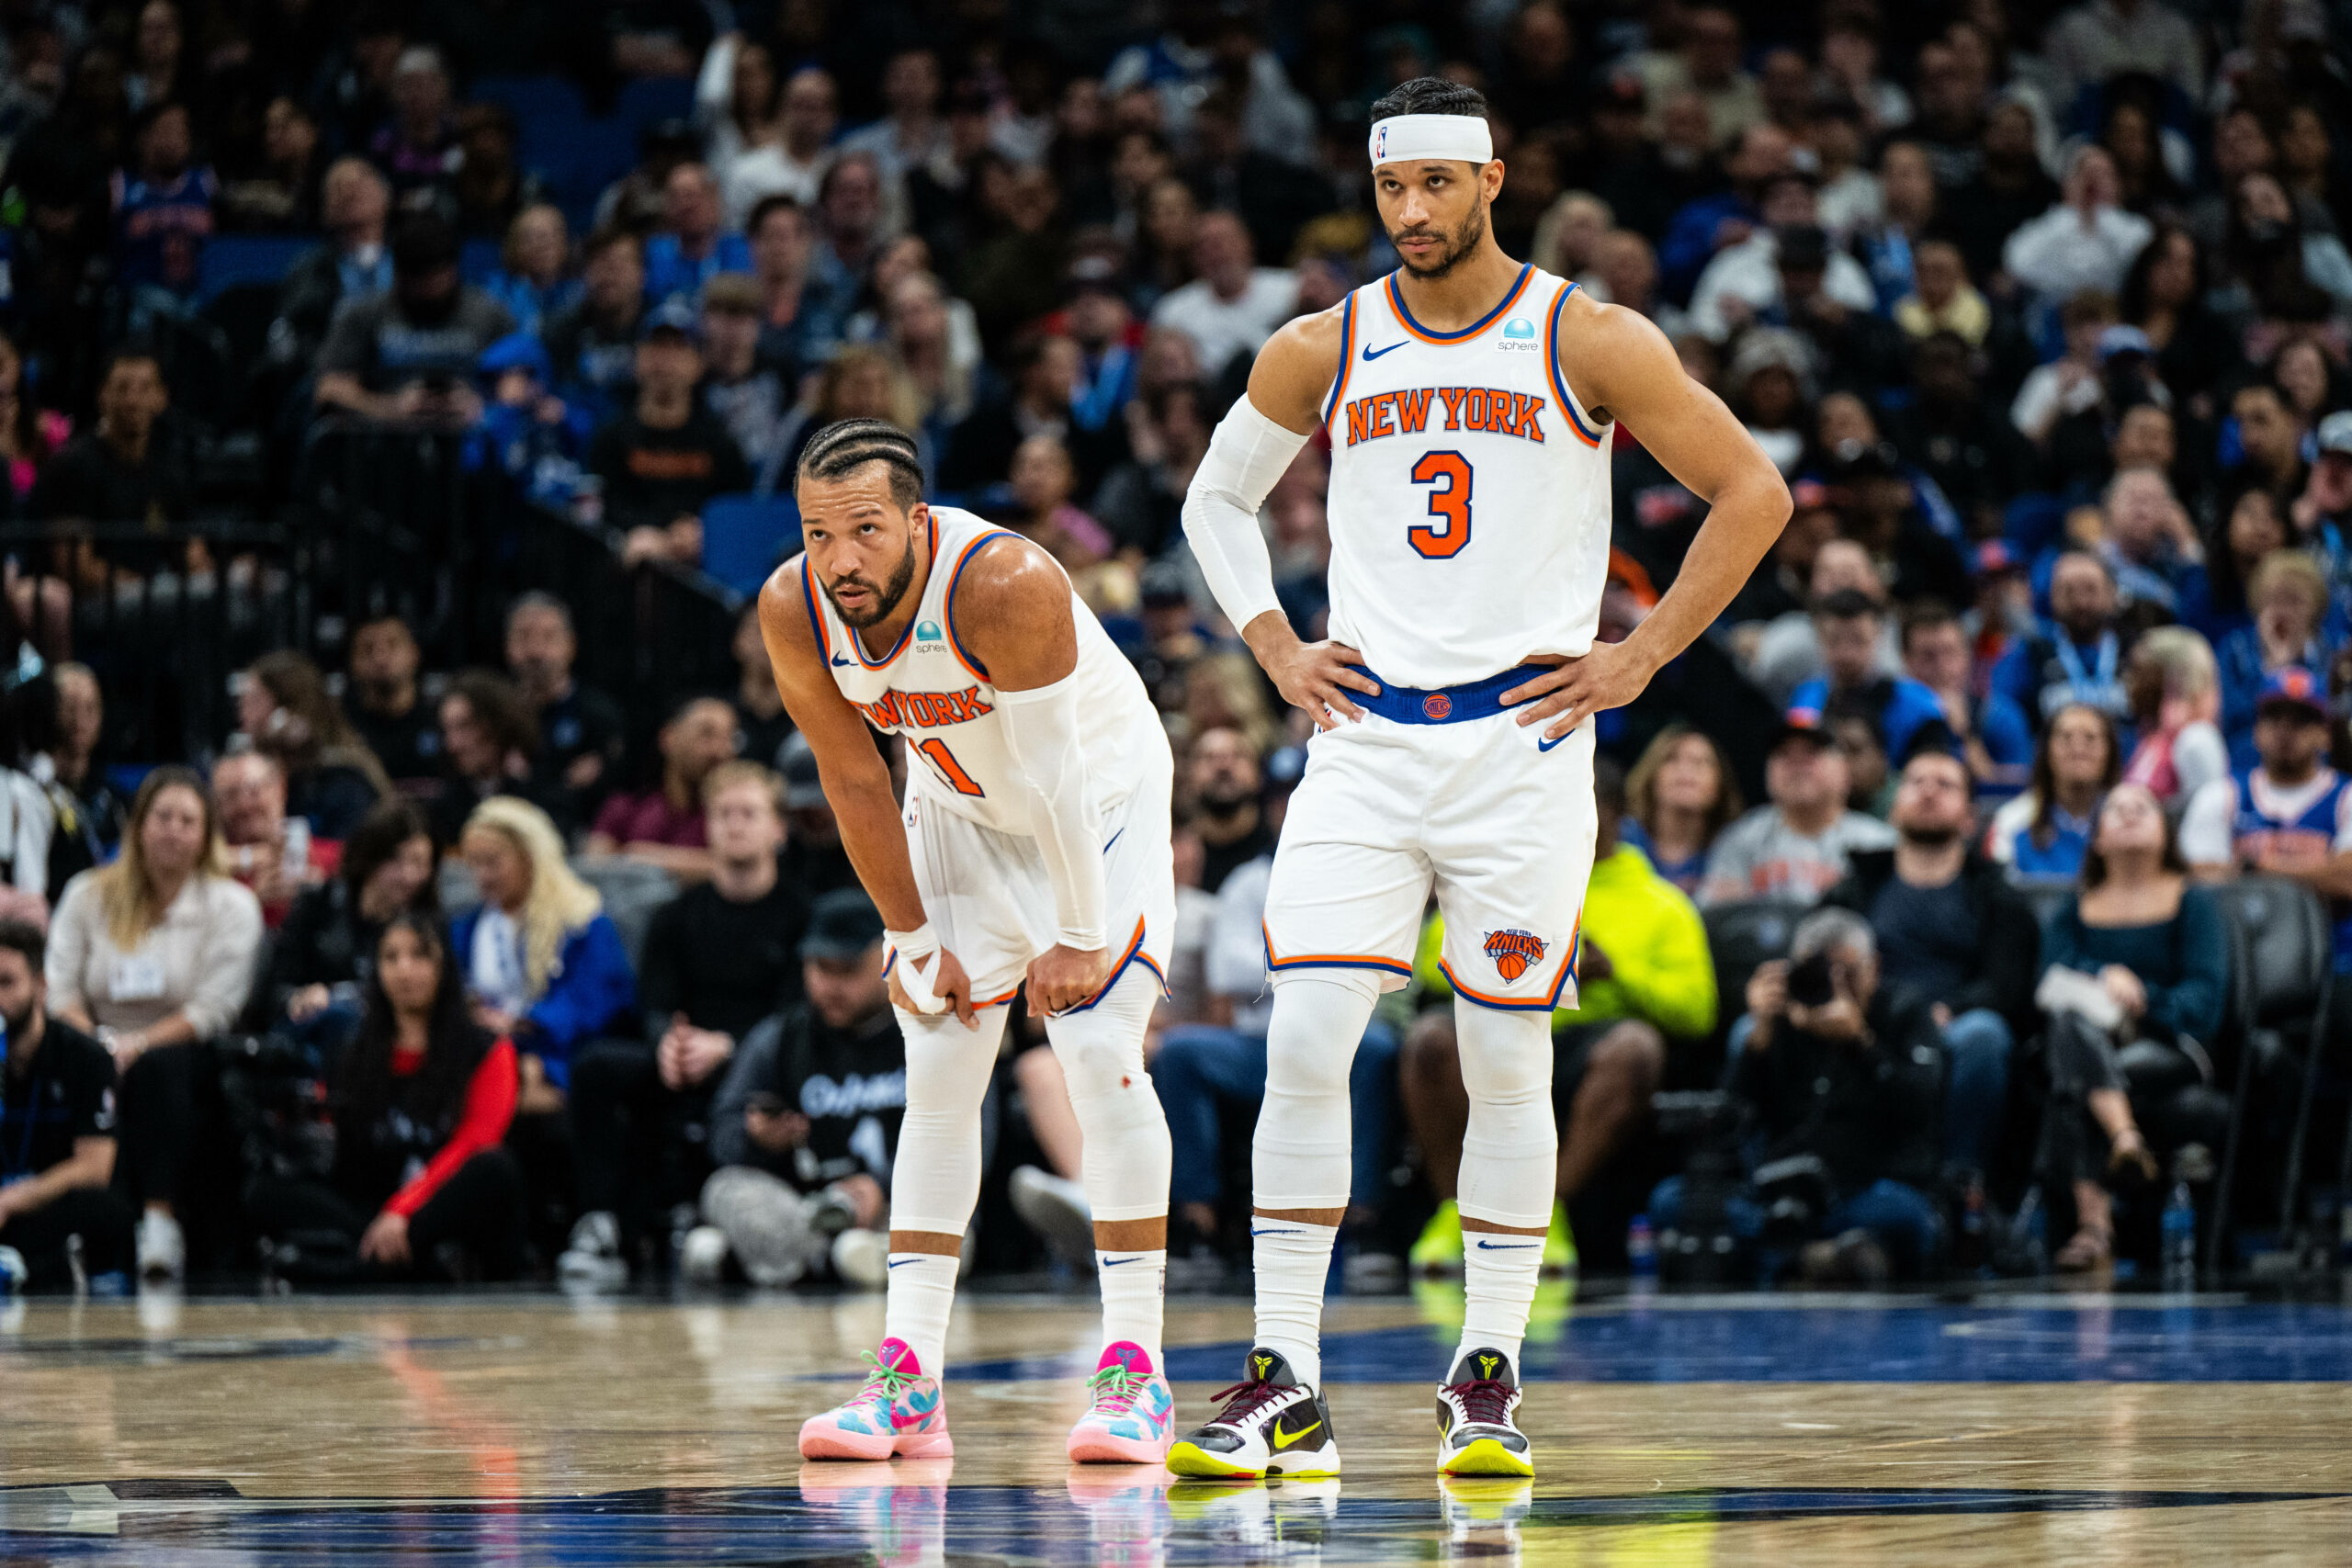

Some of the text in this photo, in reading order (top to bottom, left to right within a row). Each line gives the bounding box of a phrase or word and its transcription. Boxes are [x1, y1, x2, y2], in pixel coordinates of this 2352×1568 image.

[1498, 341, 1539, 351] sphere
[1346, 387, 1546, 448] NEW YORK
[1408, 450, 1474, 560] 3
[916, 643, 947, 654] sphere
[889, 684, 995, 728] YORK
[1483, 931, 1544, 961] KNICKS
